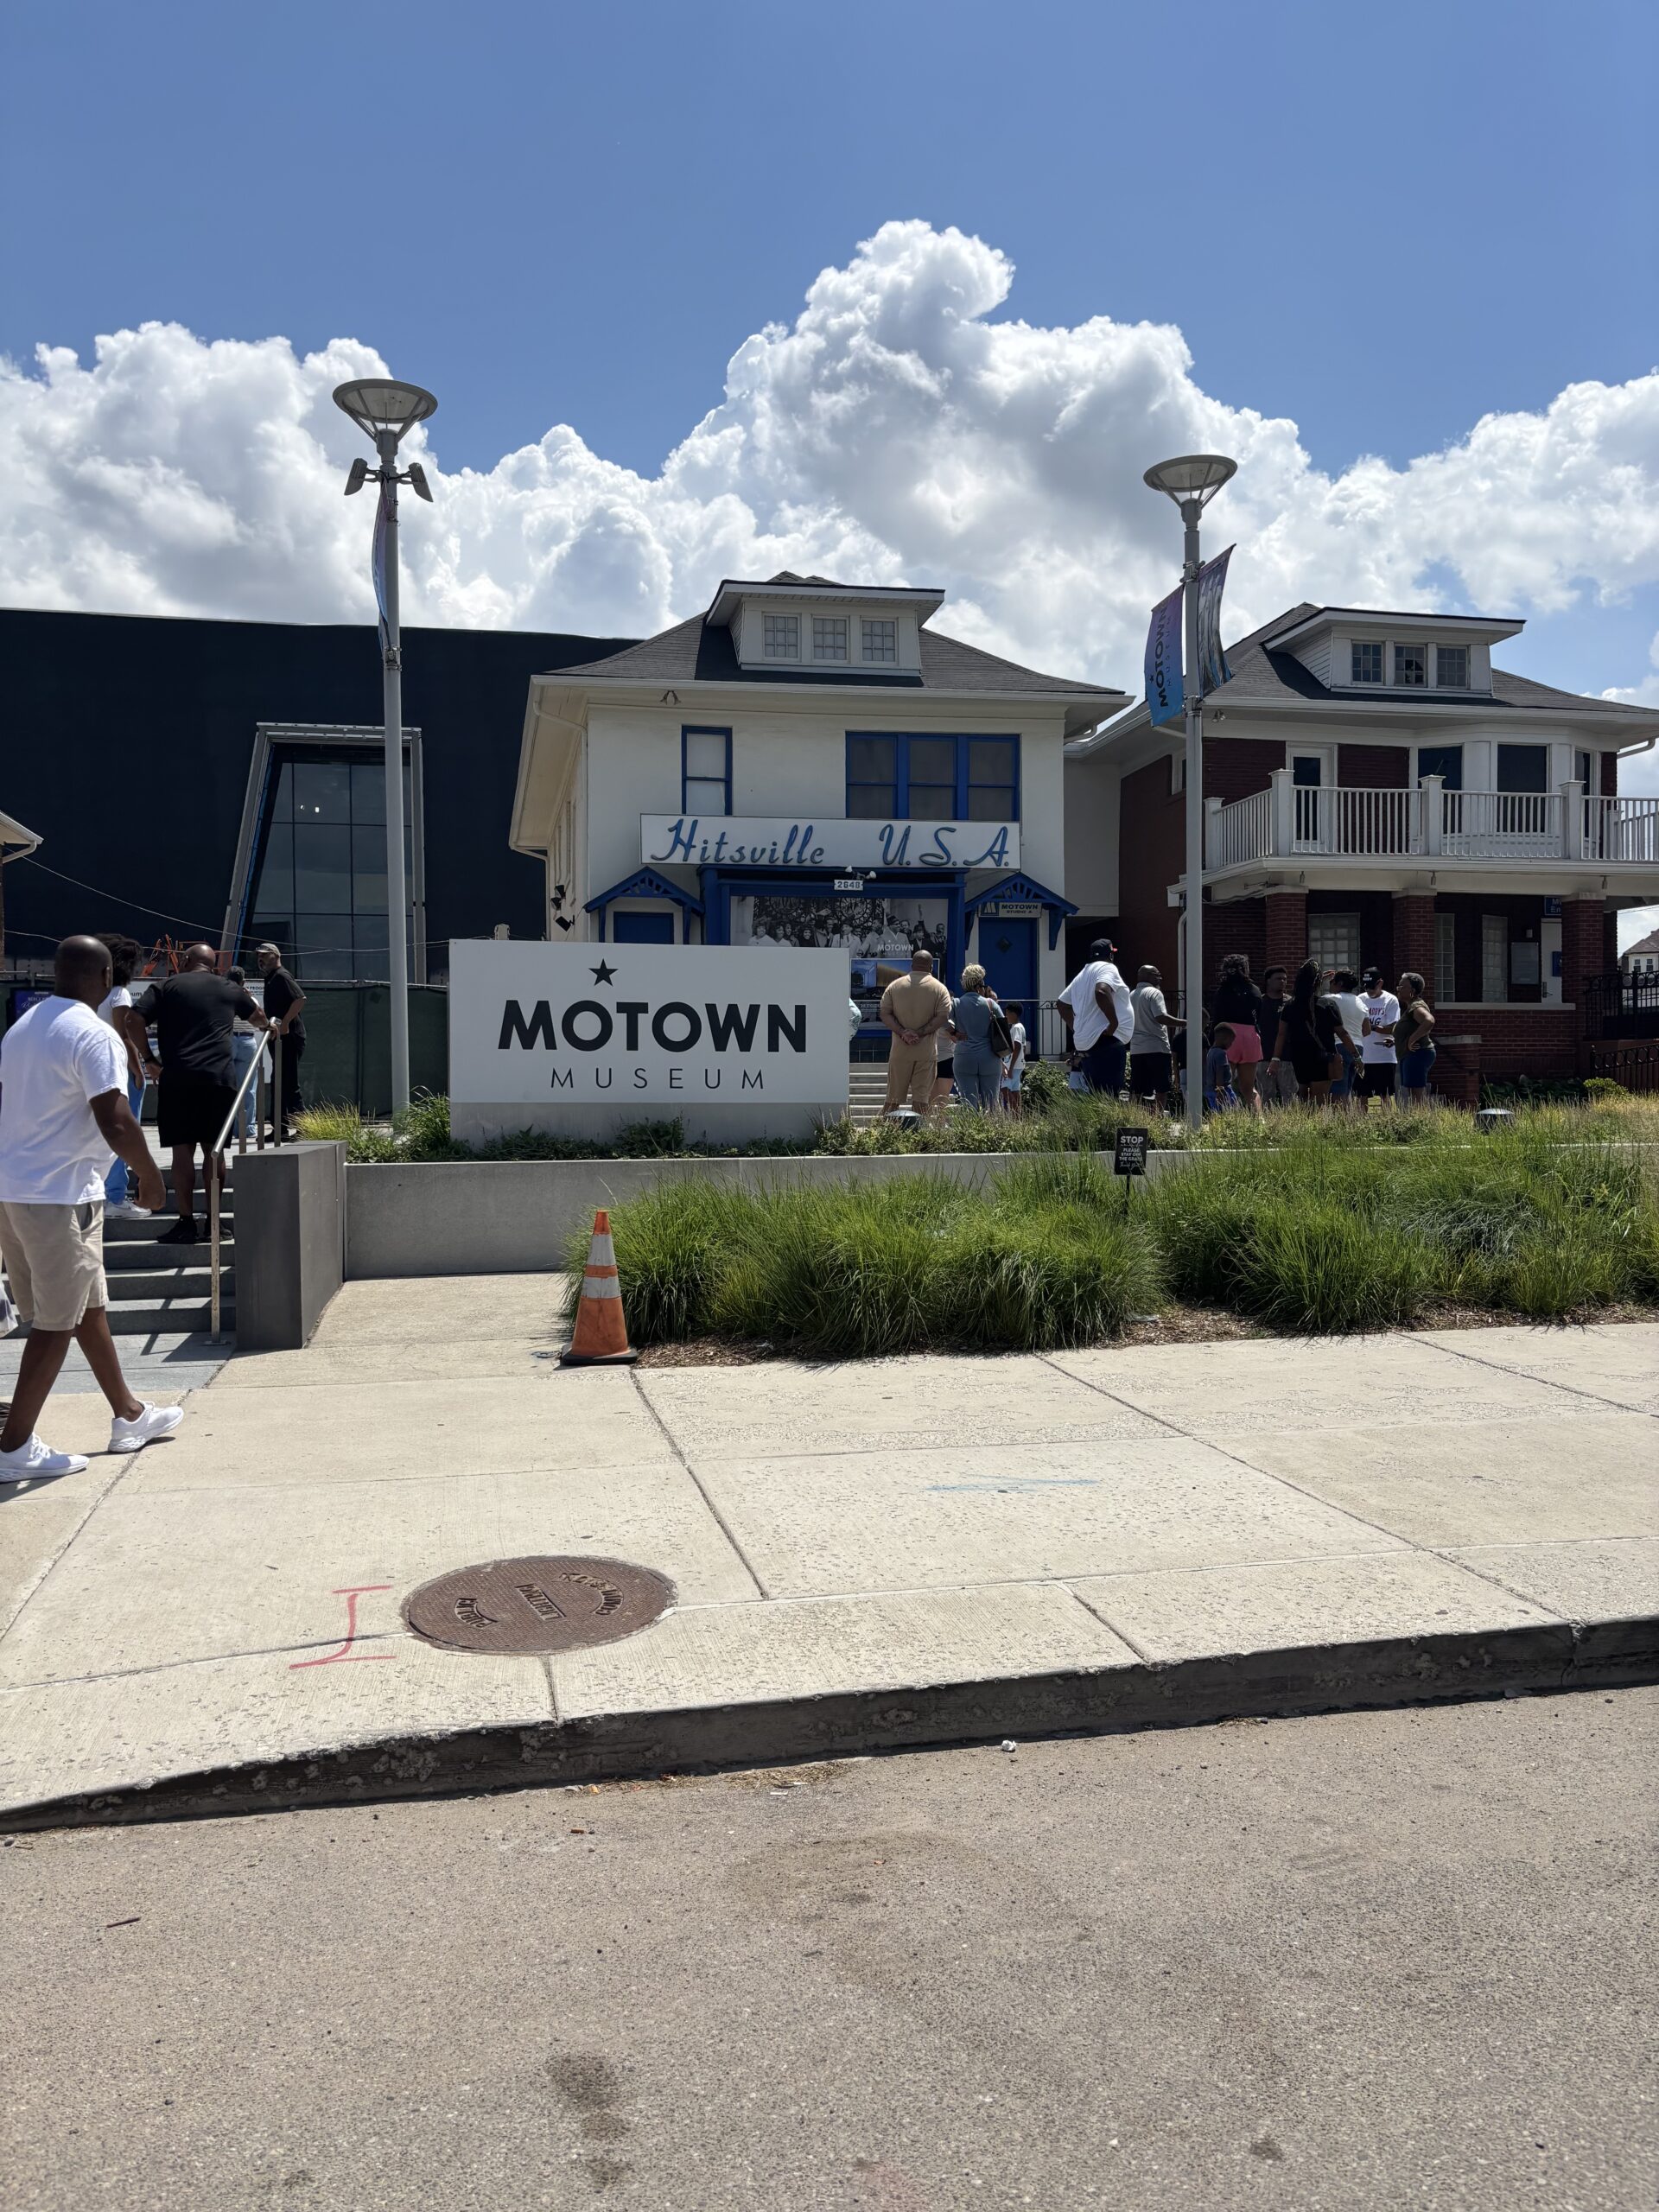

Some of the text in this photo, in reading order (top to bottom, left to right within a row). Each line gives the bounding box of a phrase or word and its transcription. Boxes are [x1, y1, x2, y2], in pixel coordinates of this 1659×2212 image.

[1154, 607, 1168, 708] MOTOWN
[650, 818, 1009, 868] Hitsville U.S.A.
[837, 880, 861, 889] 2648
[497, 1000, 807, 1053] MOTOWN
[550, 1067, 764, 1090] MUSEUM
[1120, 1135, 1144, 1144] STOP
[454, 1599, 493, 1629] PUBLIC
[518, 1583, 562, 1622] LIGHTING
